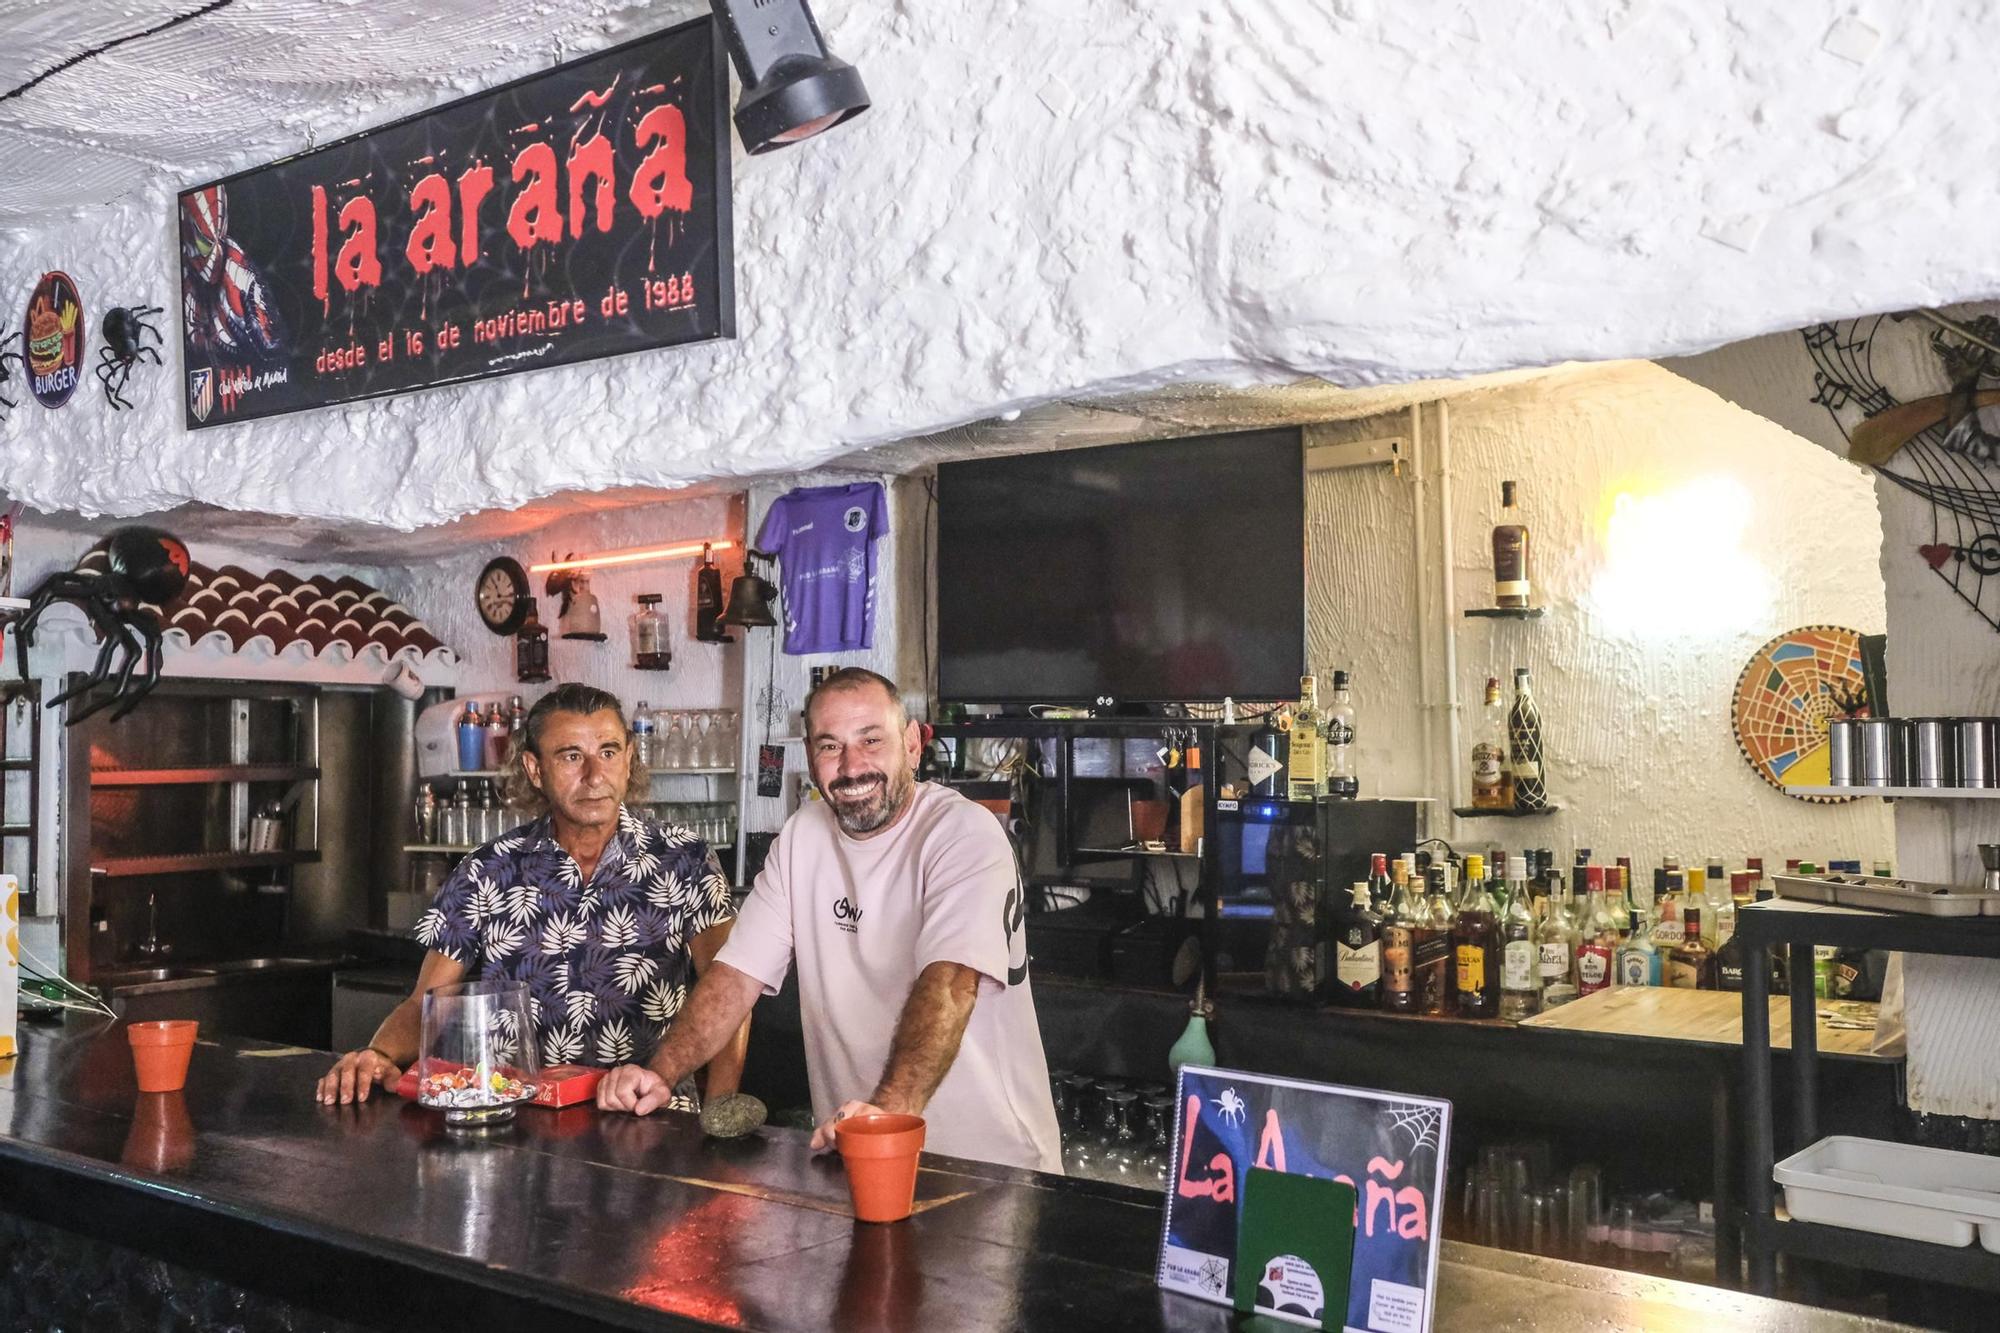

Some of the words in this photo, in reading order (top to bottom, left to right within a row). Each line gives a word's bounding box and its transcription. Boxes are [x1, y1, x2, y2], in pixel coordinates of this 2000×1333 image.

[312, 184, 382, 303] la
[405, 73, 693, 275] araña
[316, 342, 365, 373] desde
[379, 332, 393, 361] el
[406, 331, 424, 355] 16
[437, 321, 460, 349] de
[474, 298, 586, 343] noviembre
[601, 285, 629, 318] de
[644, 270, 695, 310] 1988
[35, 366, 77, 394] BURGER
[1178, 1094, 1234, 1203] La
[1251, 1108, 1427, 1241] Aña
